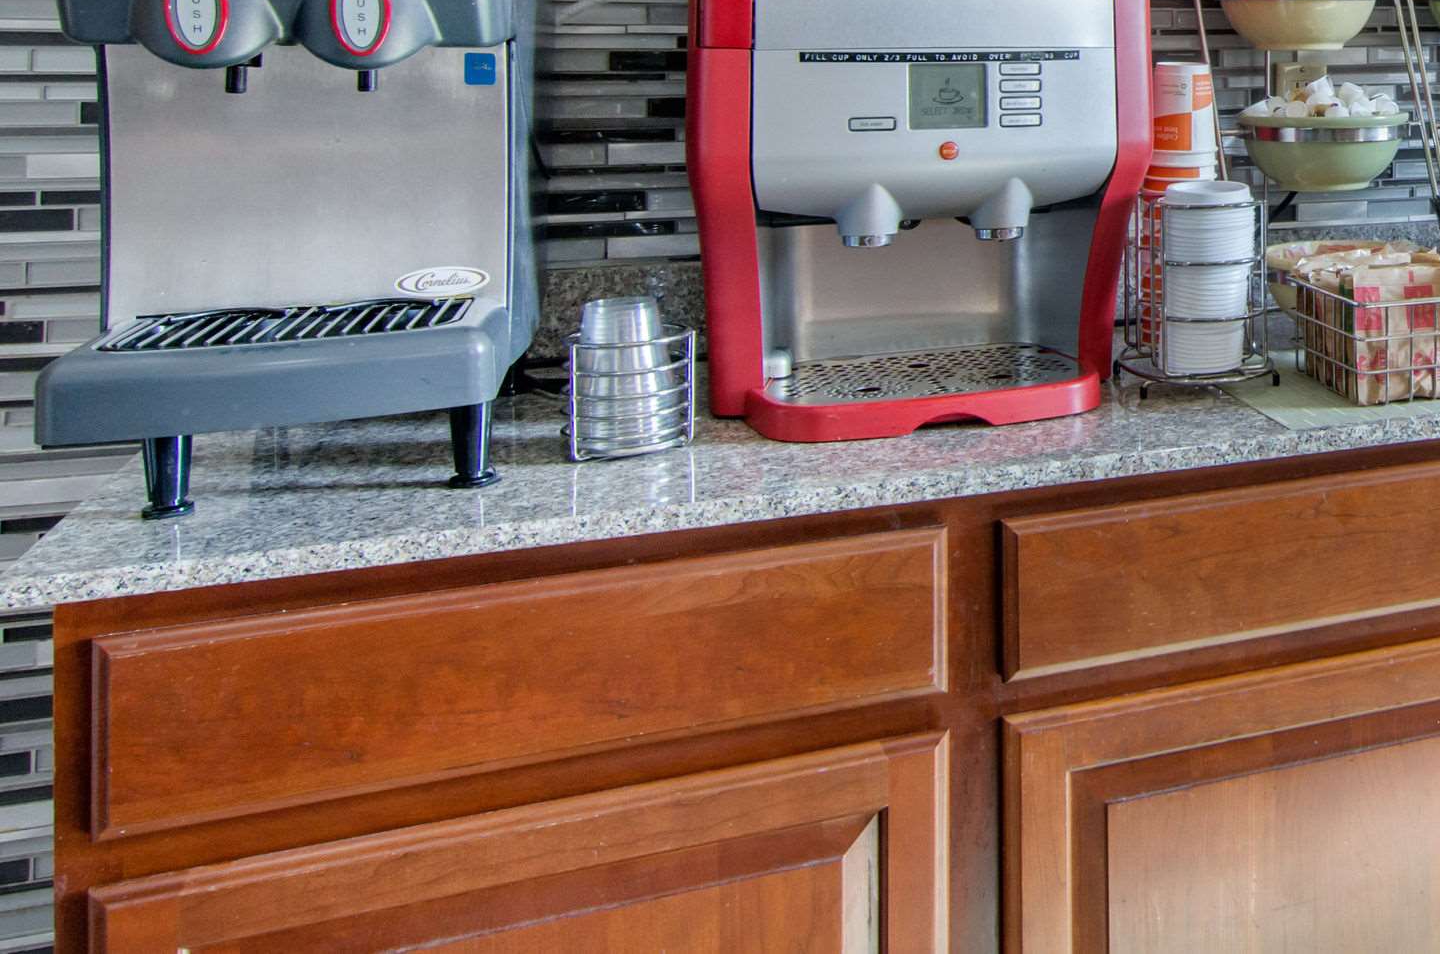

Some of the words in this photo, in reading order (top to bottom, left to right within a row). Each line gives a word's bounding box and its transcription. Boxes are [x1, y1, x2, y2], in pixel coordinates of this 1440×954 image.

[804, 53, 827, 62] FILL
[831, 53, 850, 61] CUP
[855, 53, 878, 61] ONLY
[883, 53, 901, 61] 2/3
[906, 53, 928, 61] FULL
[935, 53, 946, 61] TO
[951, 53, 979, 61] AVOID
[1063, 51, 1078, 60] CUP
